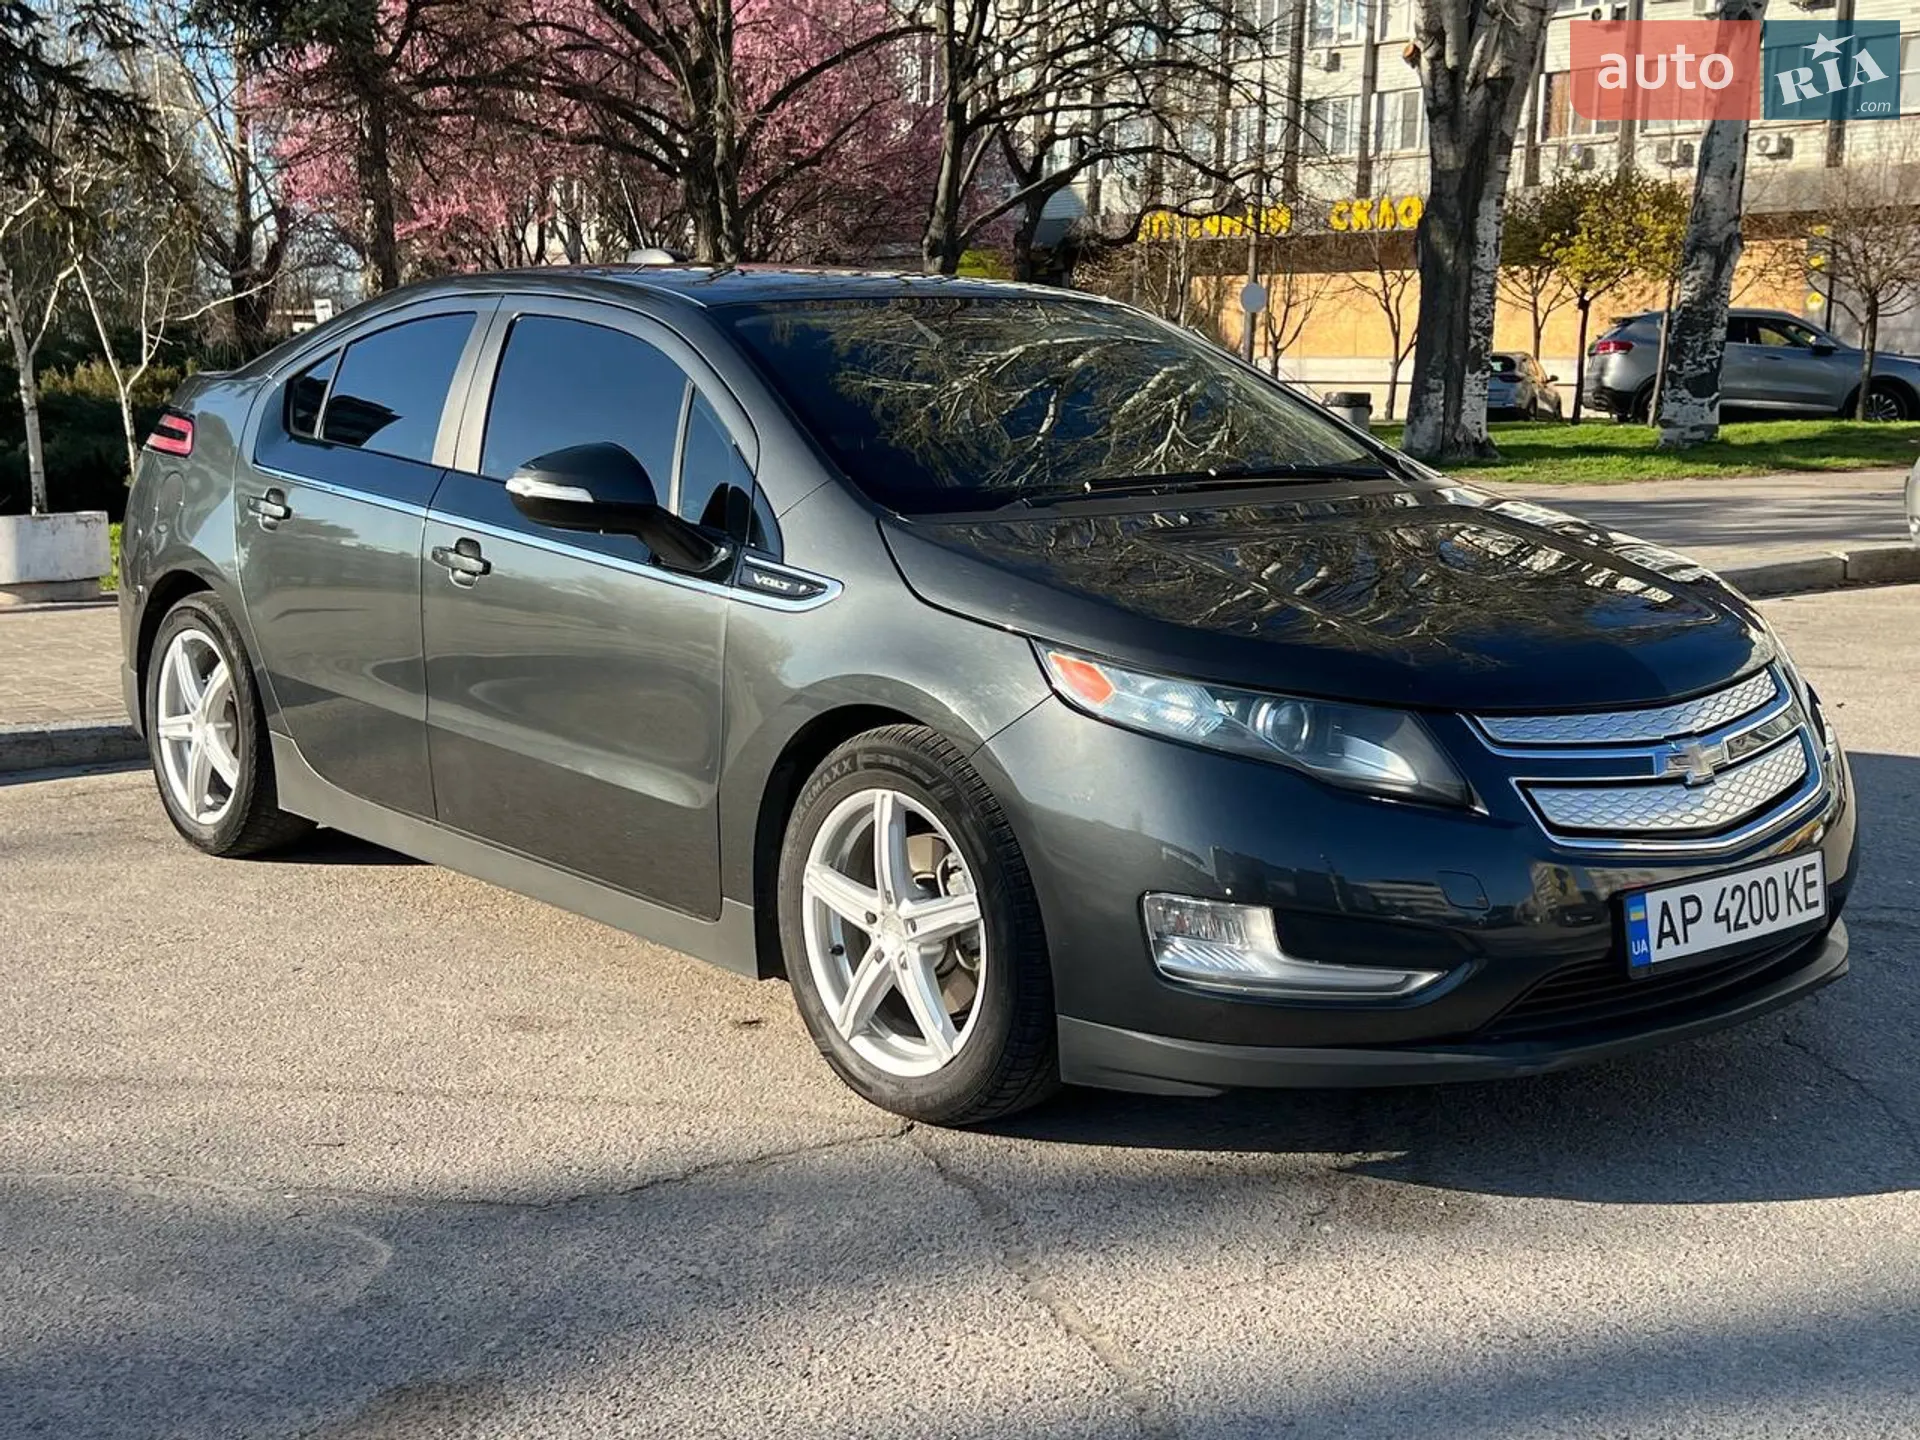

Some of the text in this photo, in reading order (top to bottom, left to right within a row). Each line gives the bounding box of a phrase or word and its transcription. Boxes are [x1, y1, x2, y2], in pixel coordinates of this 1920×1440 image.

[753, 572, 792, 591] VOLT
[1656, 862, 1820, 950] AP 4200 KE
[1631, 940, 1649, 956] UA
